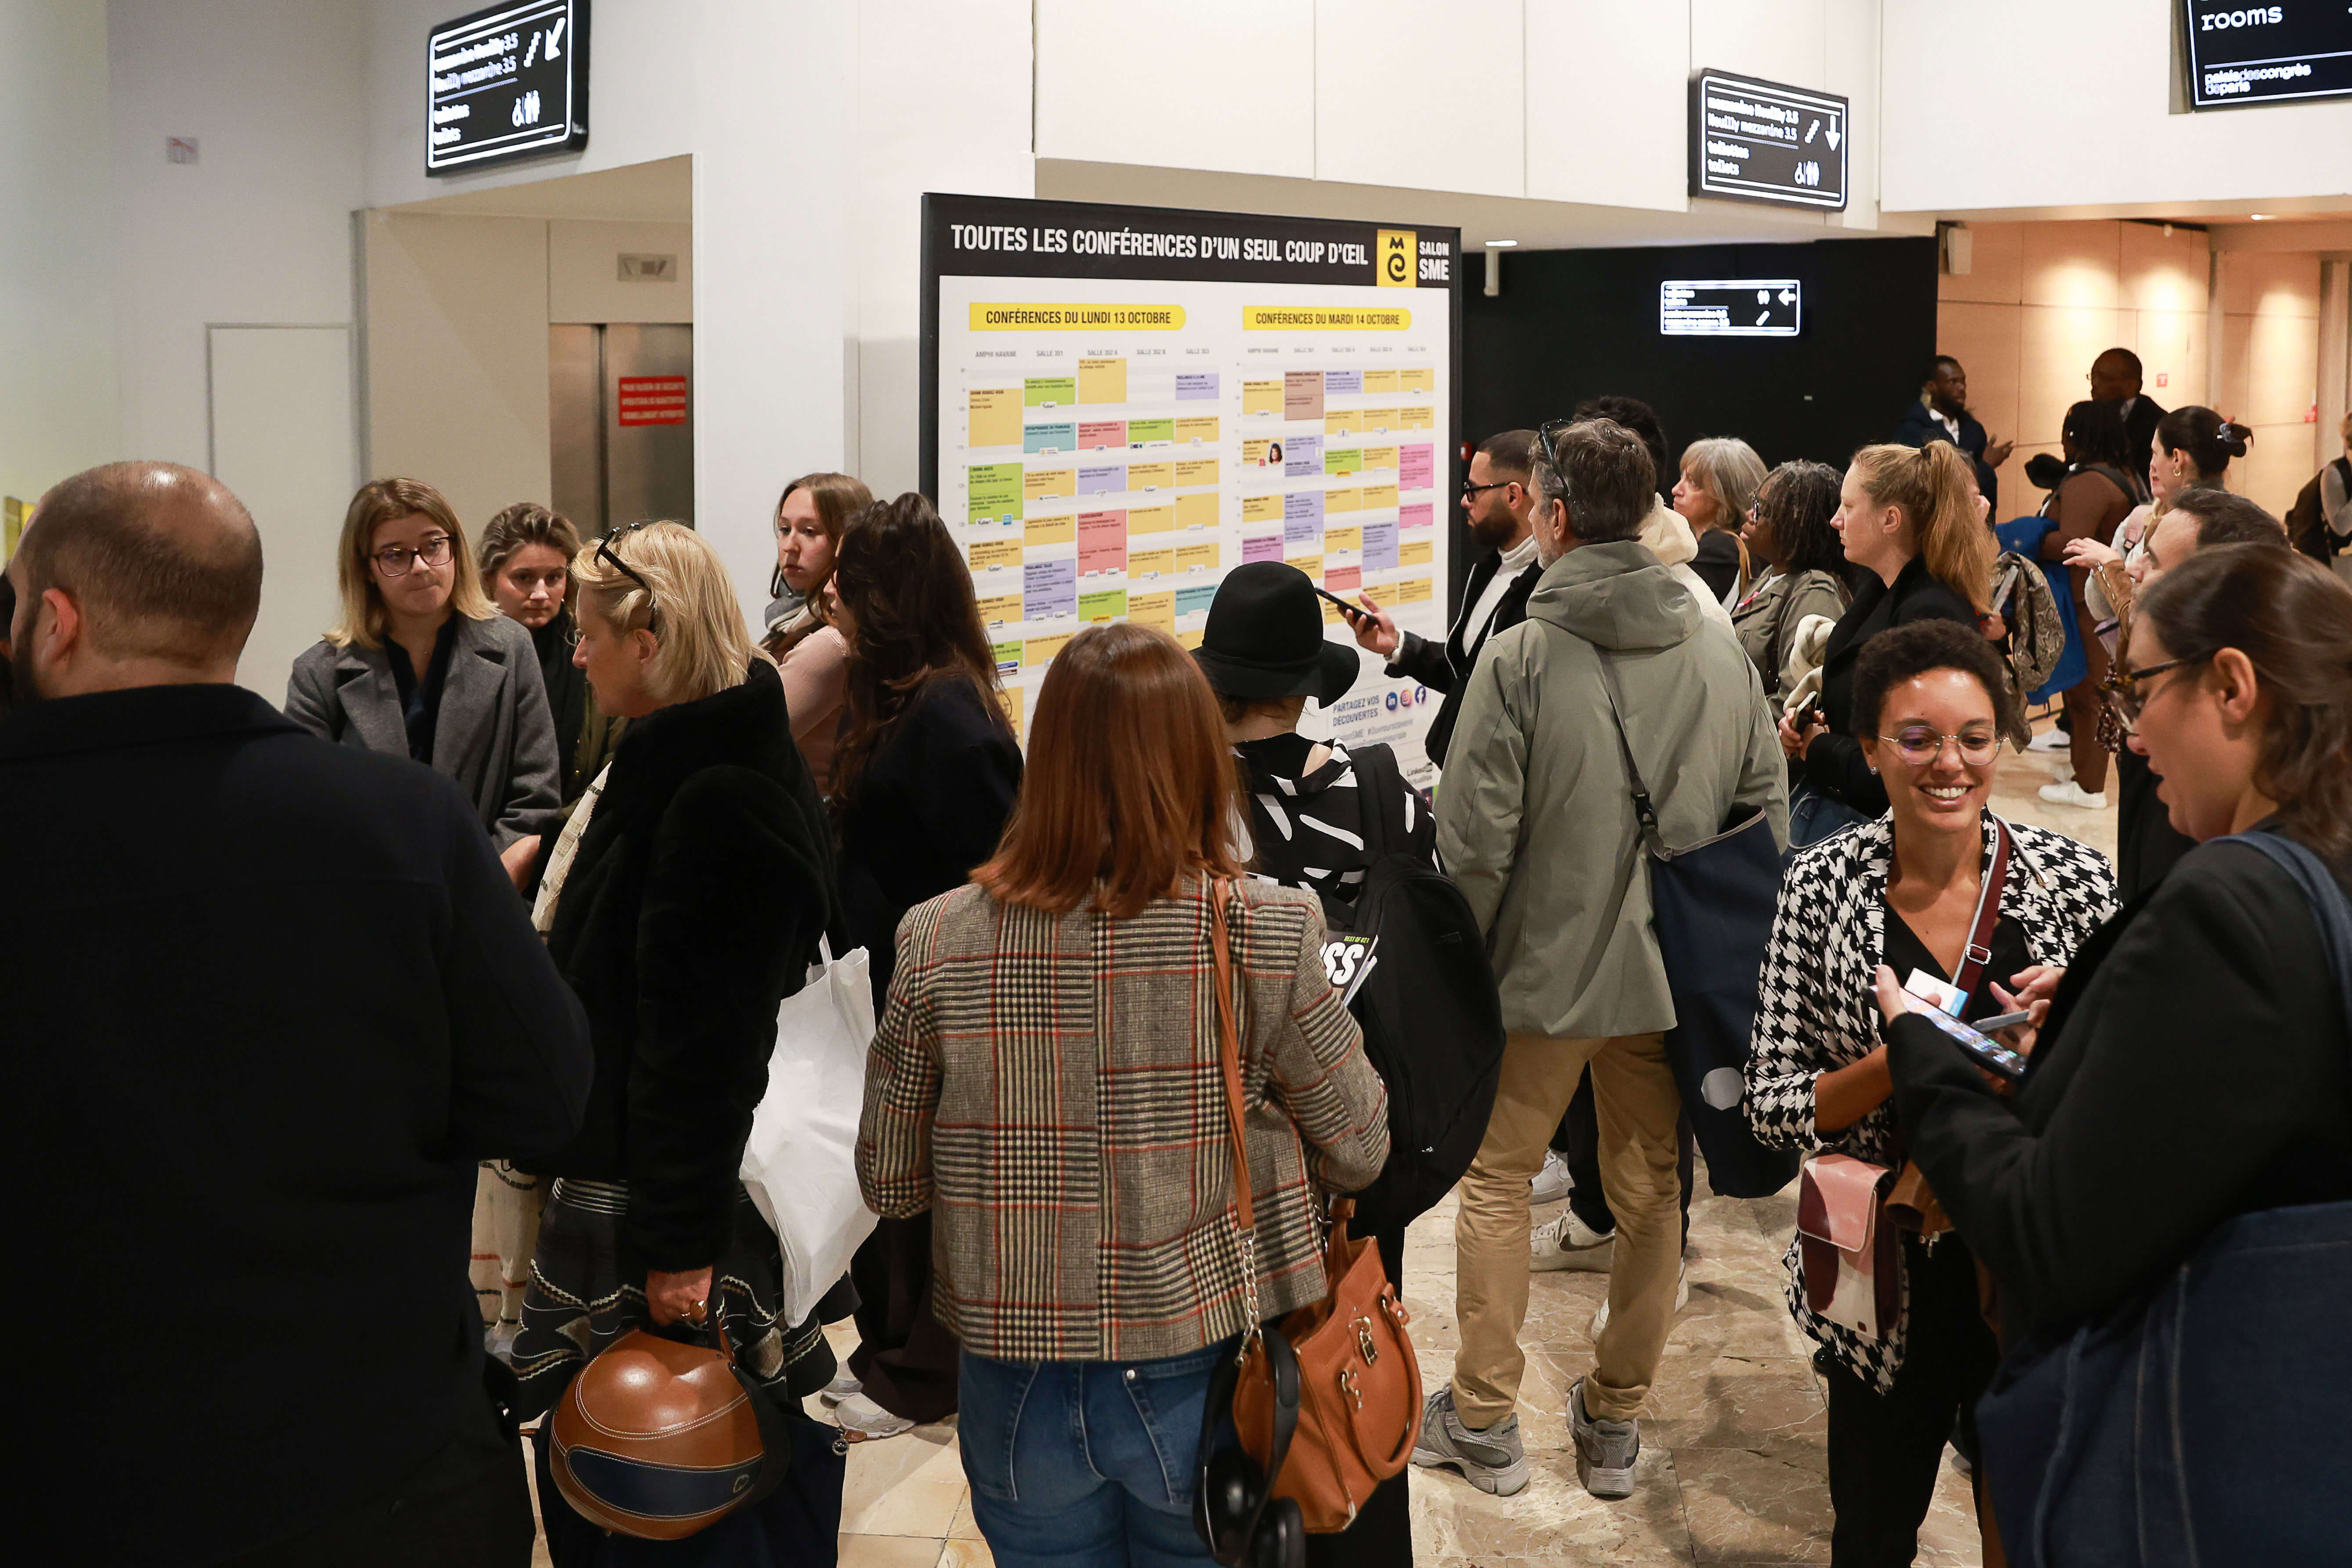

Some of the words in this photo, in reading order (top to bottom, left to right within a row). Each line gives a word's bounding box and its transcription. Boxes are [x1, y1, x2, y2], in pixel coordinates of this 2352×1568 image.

[2201, 6, 2283, 31] rooms
[951, 224, 1028, 252] TOUTES
[1033, 228, 1068, 253] LES
[1073, 227, 1197, 258] CONFÉRENCES
[1201, 236, 1239, 260] D'UN
[1243, 238, 1282, 262] SEUL
[1285, 240, 1324, 263] COUP
[1419, 240, 1449, 257] SALON
[1419, 258, 1449, 281] SME
[986, 308, 1061, 324] CONFÉRENCES
[1065, 311, 1078, 323] DU
[1081, 311, 1111, 324] LUNDI
[1114, 312, 1125, 324] 13
[1127, 311, 1171, 324] OCTOBRE
[1256, 310, 1313, 324] CONFÉRENCES
[1315, 314, 1326, 324] DU
[1328, 314, 1353, 324] MARDI
[1356, 314, 1364, 324] 14
[1366, 314, 1400, 324] OCTOBRE
[1333, 698, 1365, 714] PARTAGEZ
[1367, 695, 1380, 706] VOS
